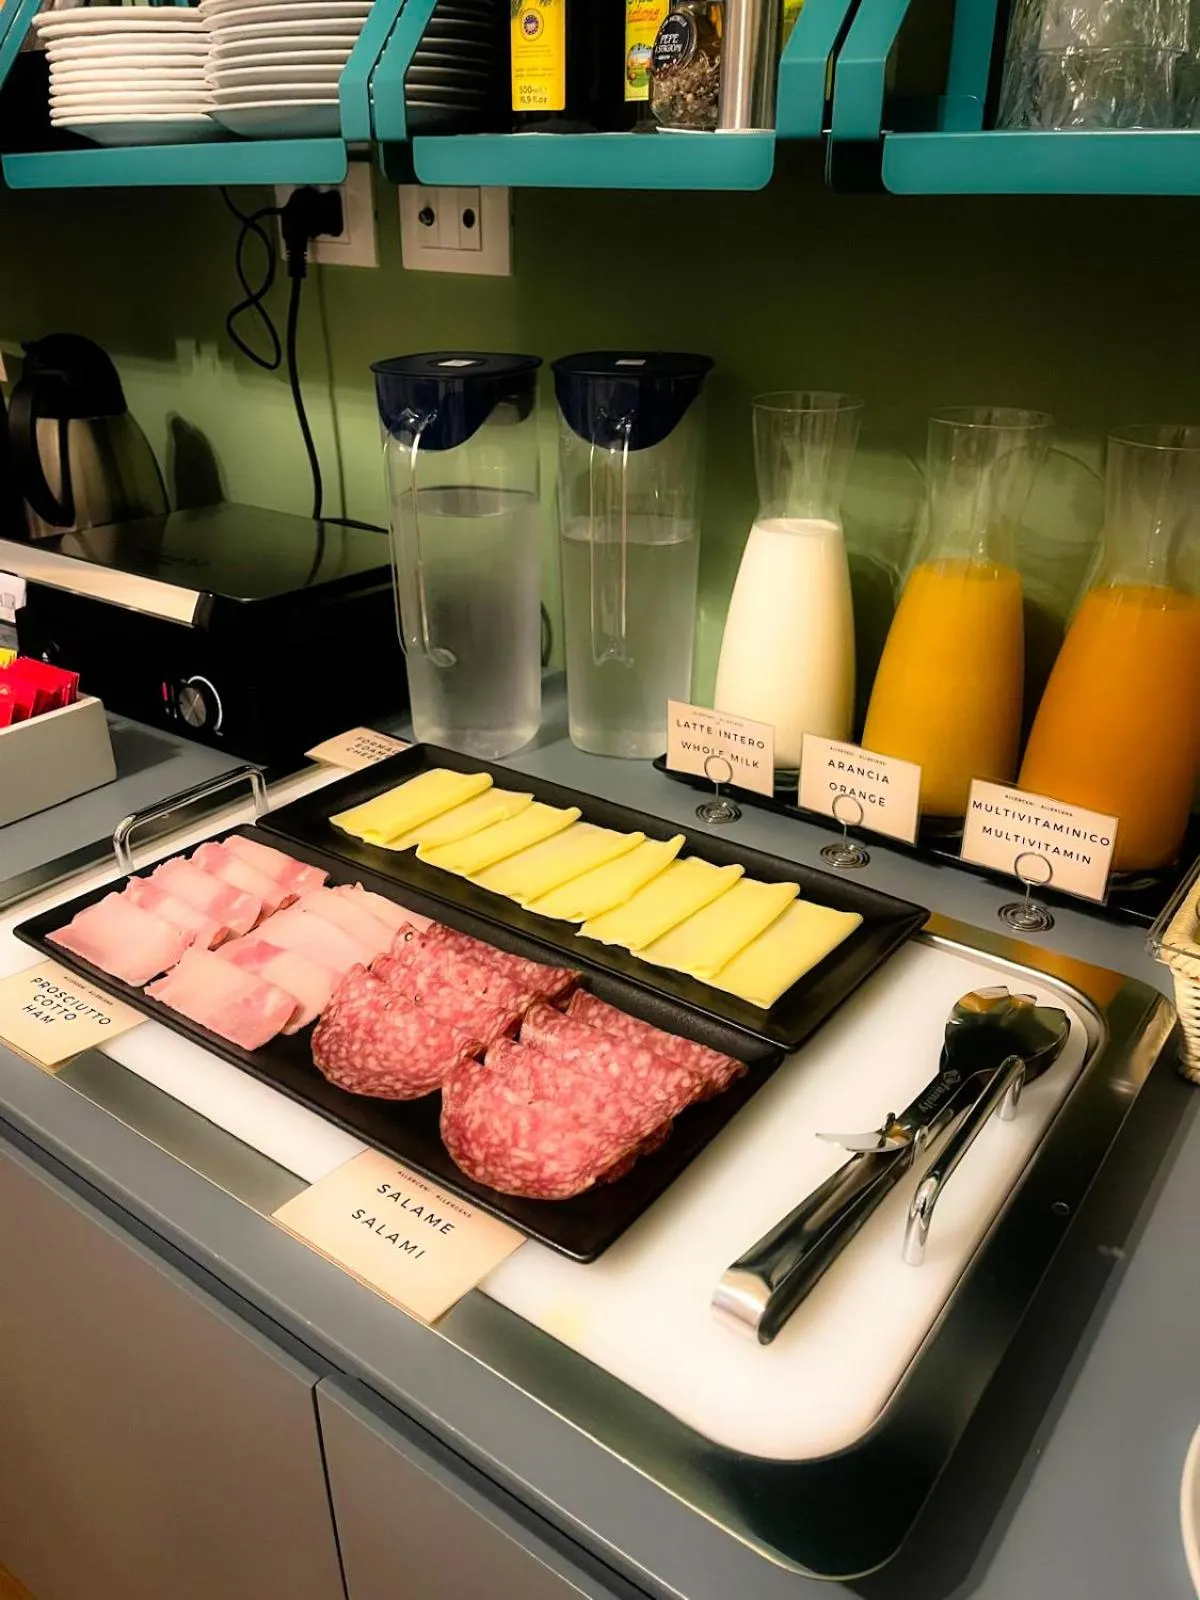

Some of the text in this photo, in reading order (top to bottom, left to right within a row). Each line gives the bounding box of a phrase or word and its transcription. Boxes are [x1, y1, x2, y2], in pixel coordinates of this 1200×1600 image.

[676, 719, 713, 735] LATTE
[718, 730, 766, 750] INTERO
[681, 740, 760, 770] WHOLE MILK
[828, 760, 889, 784] ARANCIA
[829, 782, 886, 807] ORANGE
[972, 800, 1110, 847] MULTIVITAMINICO
[982, 826, 1092, 865] MULTIVITAMIN
[22, 1004, 56, 1024] HAM
[30, 977, 112, 1025] PROSCIUTTO
[33, 994, 77, 1021] COTTO
[376, 1183, 455, 1235] SALAME
[351, 1208, 426, 1260] SALAMI
